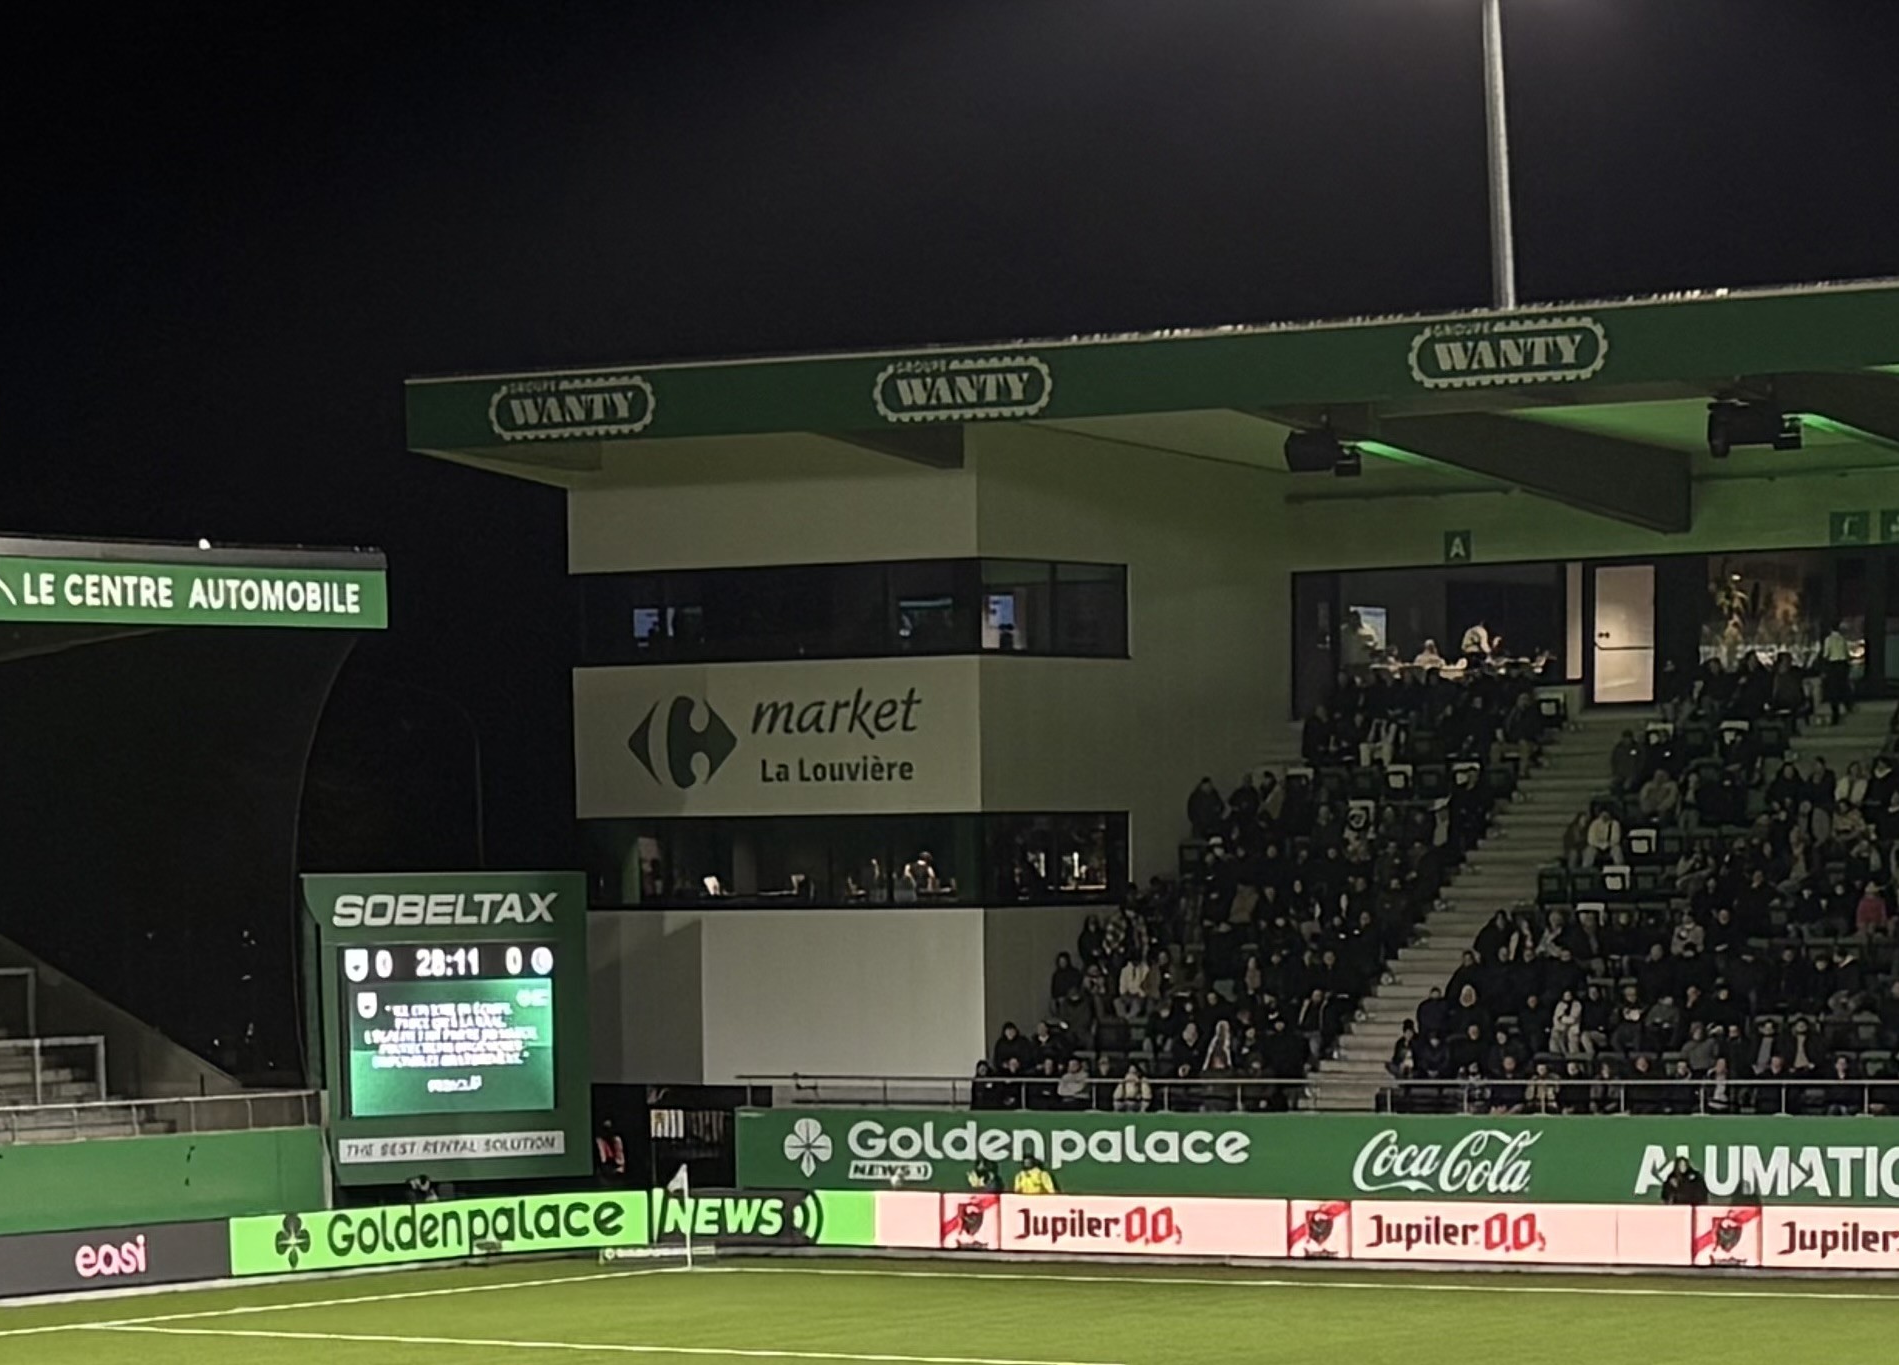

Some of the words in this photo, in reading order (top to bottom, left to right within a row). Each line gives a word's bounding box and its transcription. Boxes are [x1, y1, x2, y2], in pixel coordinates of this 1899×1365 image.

[1434, 334, 1584, 373] WANTY
[895, 372, 1030, 407] WANTY
[509, 391, 634, 426] WANTY
[1448, 534, 1466, 560] A
[23, 571, 55, 606] LE
[64, 573, 174, 609] CENTRE
[187, 577, 361, 614] AUTOMOBILE
[751, 685, 923, 740] market
[760, 757, 790, 783] La
[798, 756, 914, 783] Louvière
[332, 892, 559, 928] SOBELTAX
[375, 949, 393, 979] 0
[505, 946, 523, 976] 0
[346, 1143, 373, 1158] THE
[380, 1141, 417, 1157] BEST
[422, 1139, 477, 1154] RENTAL
[484, 1136, 557, 1152] SOLUTION
[847, 1118, 1252, 1170] Goldenpalace
[326, 1197, 626, 1257] Goldenpalace
[661, 1195, 784, 1237] NEWS
[1016, 1208, 1119, 1244] Jupiler
[1366, 1214, 1479, 1250] Jupiler
[75, 1234, 146, 1281] easi
